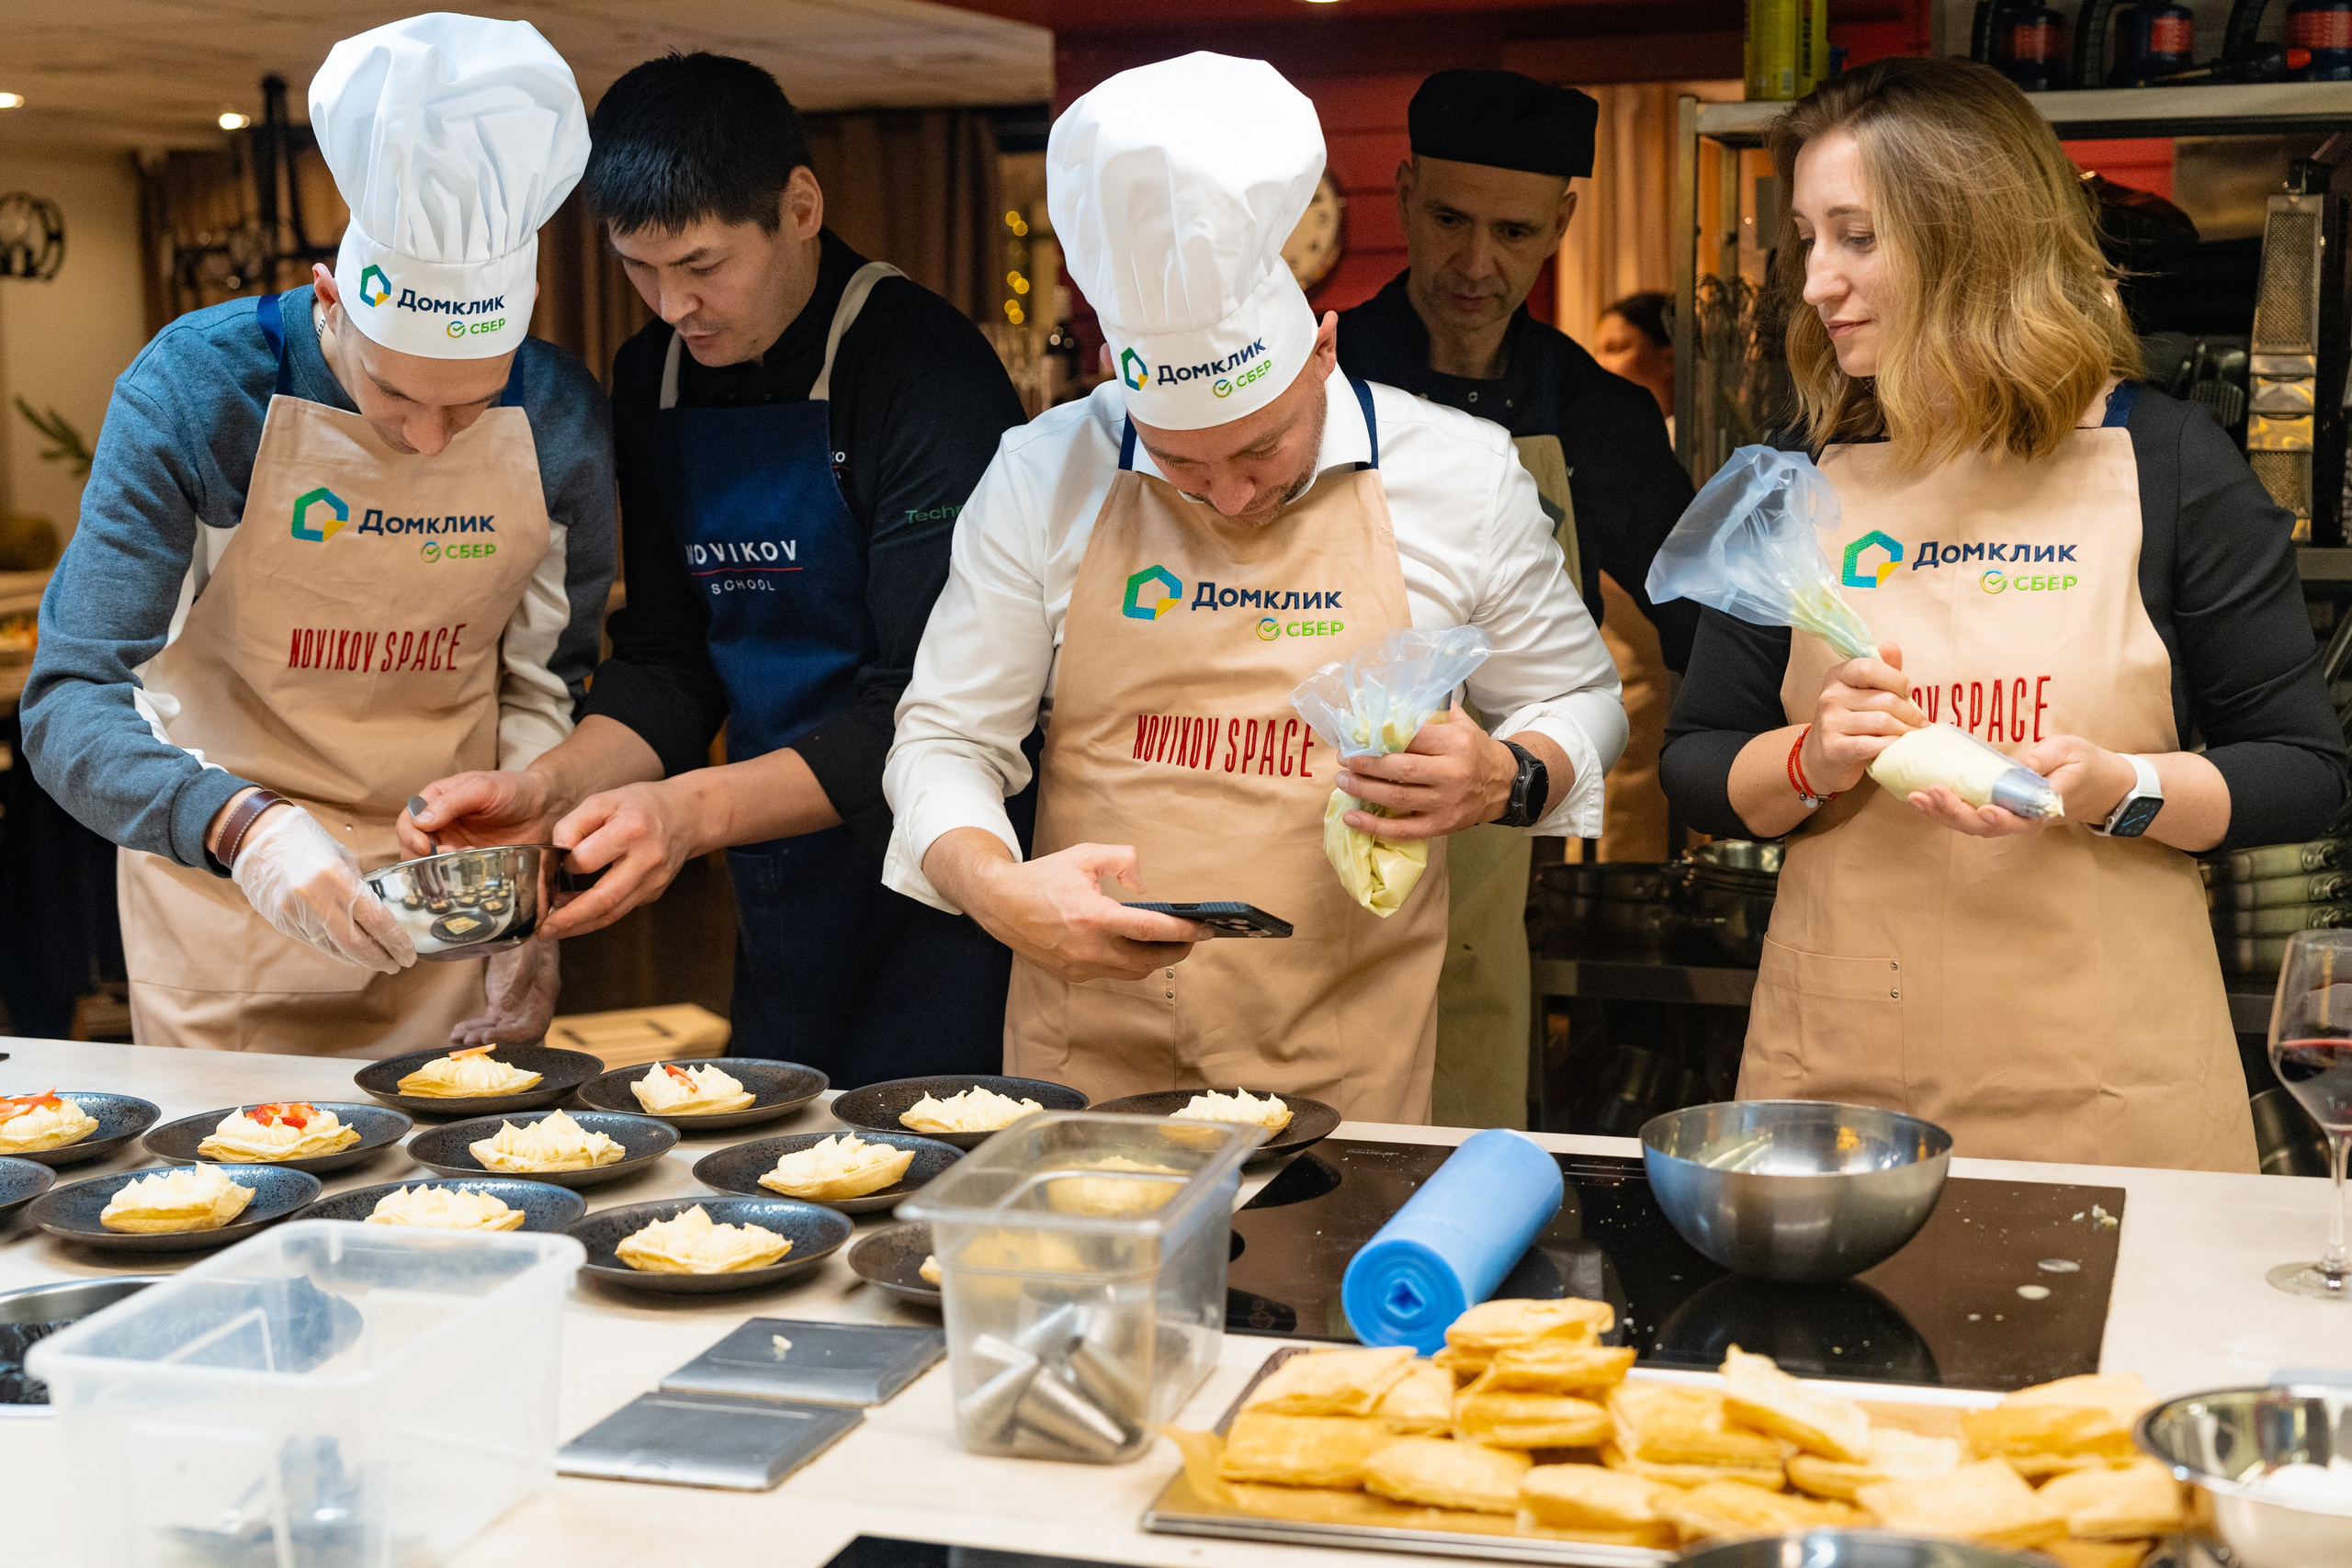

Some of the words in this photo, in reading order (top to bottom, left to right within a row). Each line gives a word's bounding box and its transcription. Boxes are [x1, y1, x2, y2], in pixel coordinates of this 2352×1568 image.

[397, 288, 505, 316] Домклик
[469, 318, 506, 335] СБЕР
[1157, 337, 1266, 386] Домклик
[1236, 359, 1272, 388] СБЕР
[358, 508, 495, 536] Домклик
[445, 544, 497, 559] СБЕР
[684, 539, 797, 565] NOVIKOV
[1912, 541, 2078, 570] Домклик
[710, 579, 775, 595] SCHOOL
[1192, 581, 1343, 612] Домклик
[2013, 574, 2078, 591] СБЕР
[1286, 620, 1344, 637] СБЕР
[288, 628, 378, 673] NOVIKOV
[380, 623, 467, 672] SPACE
[1950, 675, 2051, 742] SPACE
[1133, 714, 1219, 771] NOVIKOV
[1224, 717, 1315, 778] SPACE
